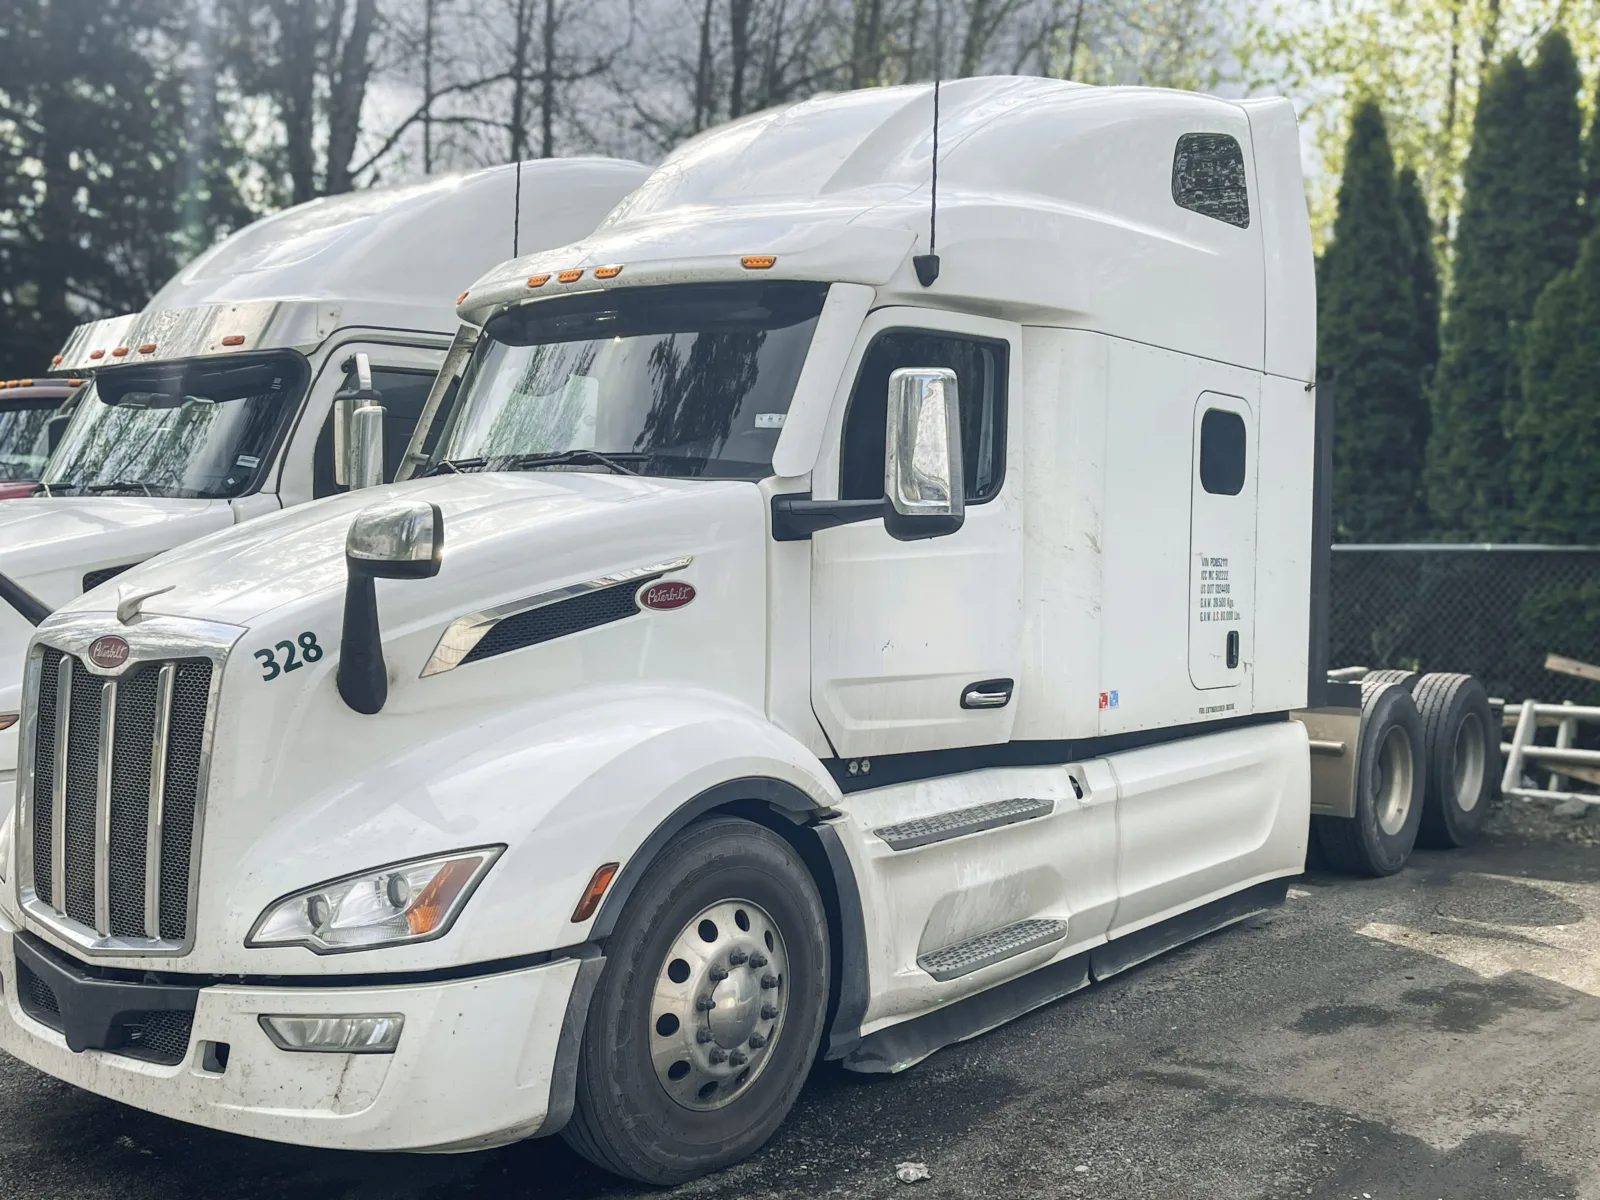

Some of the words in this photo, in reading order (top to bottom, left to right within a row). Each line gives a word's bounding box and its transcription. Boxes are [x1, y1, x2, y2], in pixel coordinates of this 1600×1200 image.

[1201, 557, 1209, 567] VIN
[647, 587, 691, 605] Peterbilt
[93, 641, 127, 659] Peterbilt
[253, 631, 323, 682] 328
